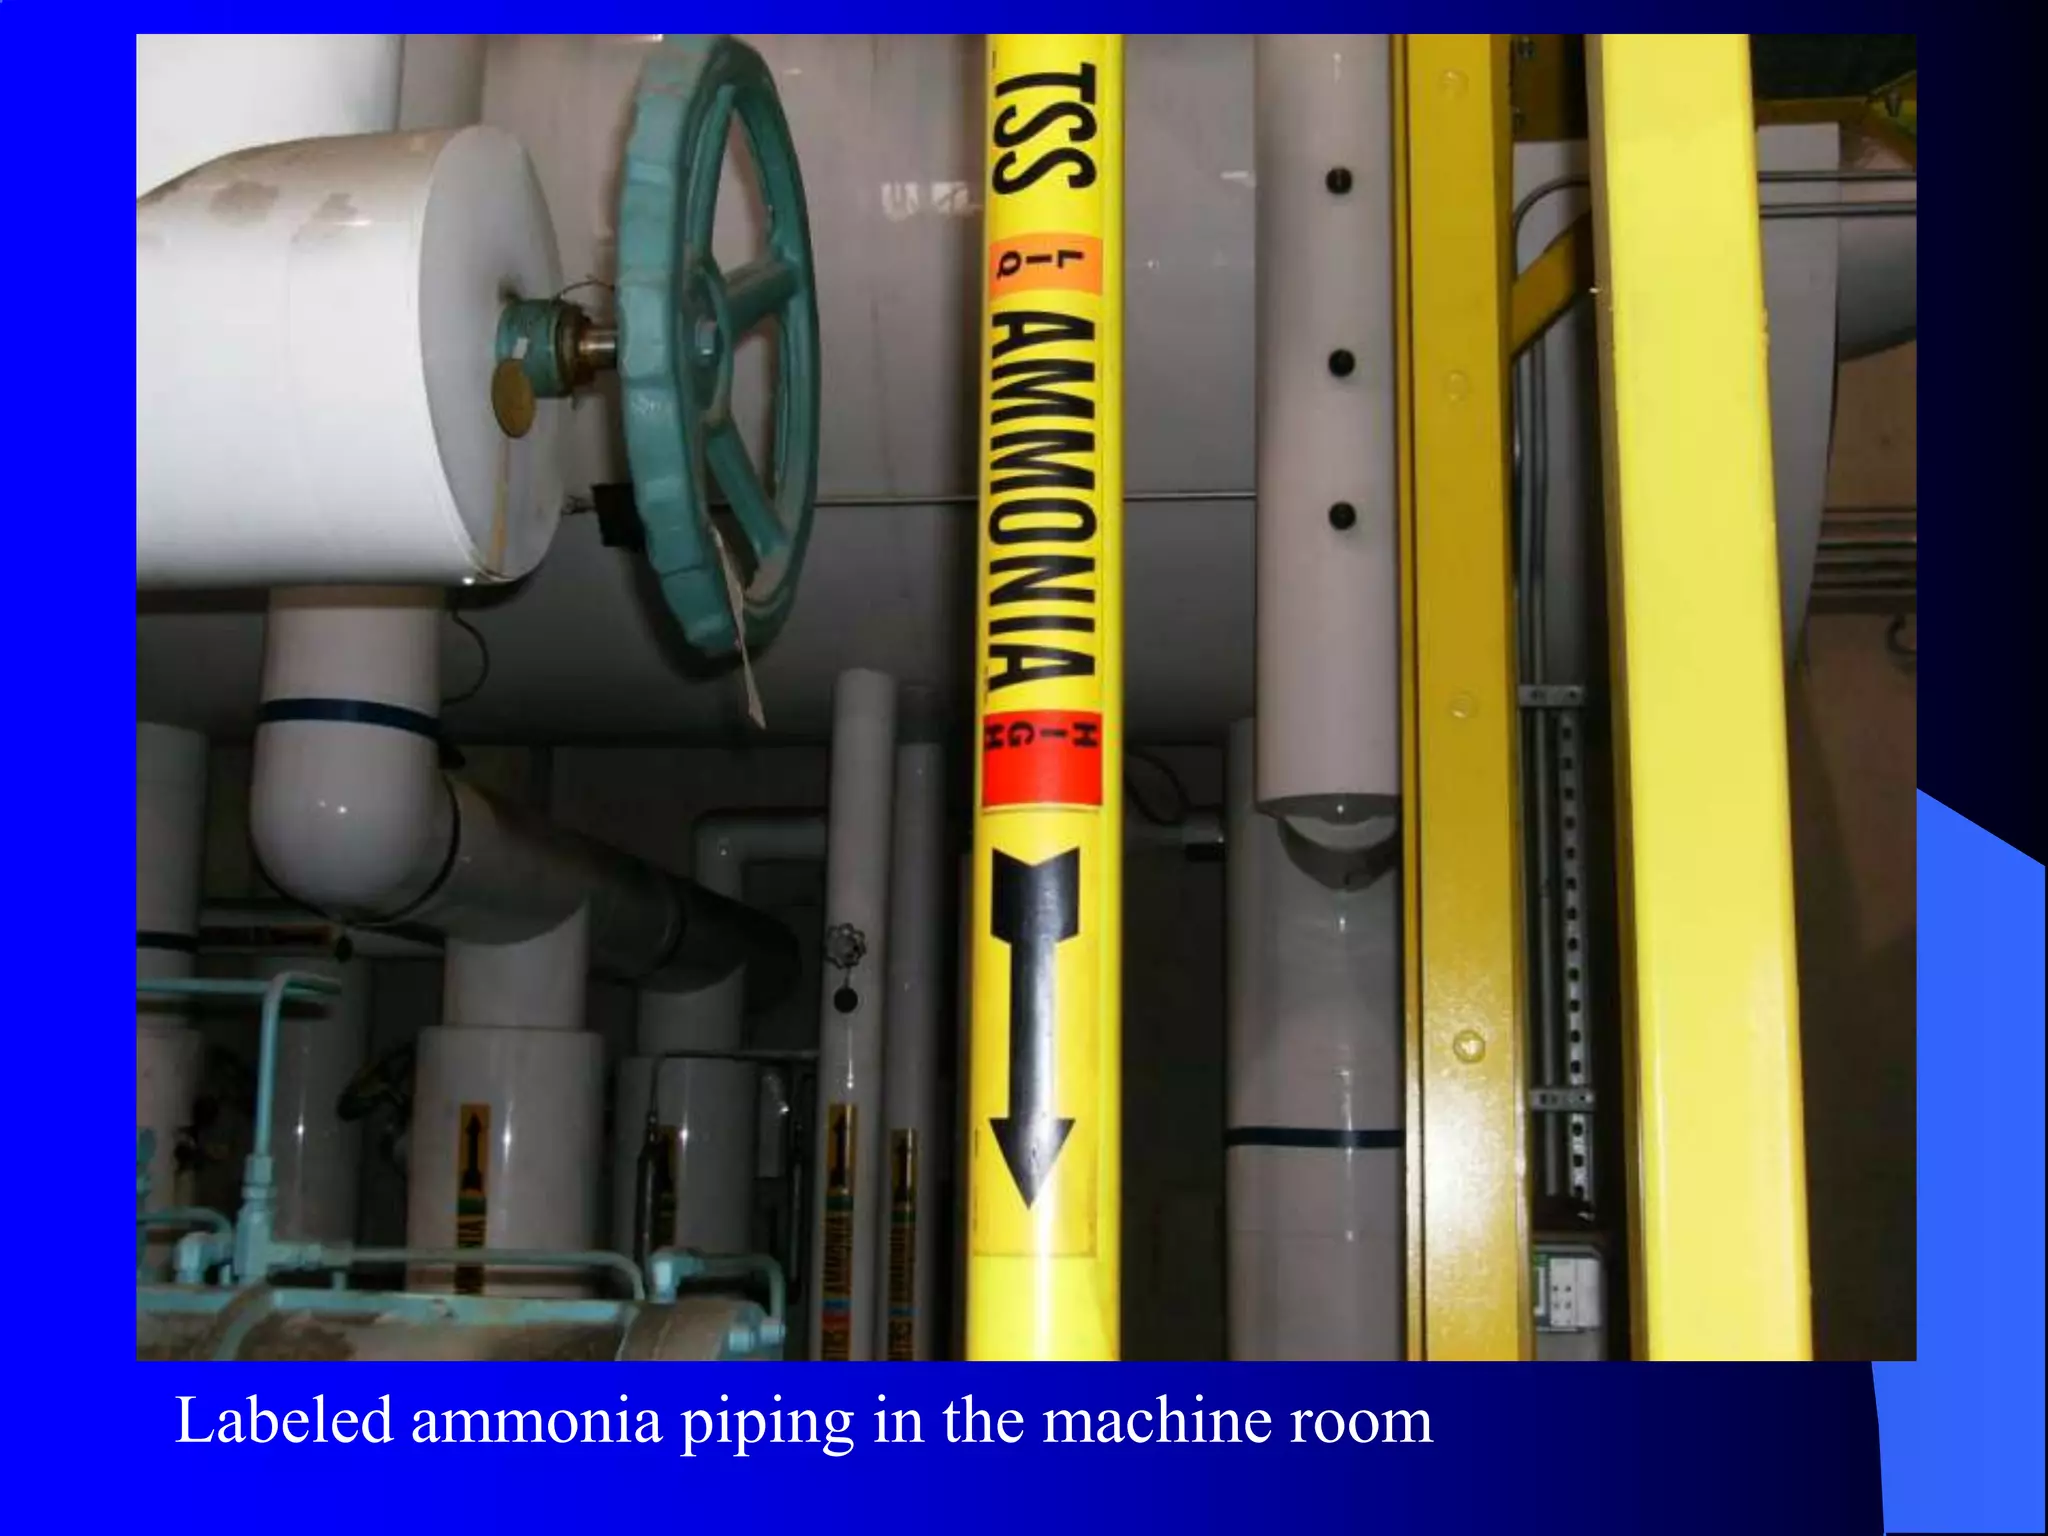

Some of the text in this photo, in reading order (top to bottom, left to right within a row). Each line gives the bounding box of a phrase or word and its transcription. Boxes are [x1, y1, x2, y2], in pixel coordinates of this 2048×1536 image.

[993, 62, 1097, 195] TSS
[997, 249, 1084, 279] LIQ
[989, 310, 1096, 692] AMMONIA
[984, 720, 1098, 751] HIGH
